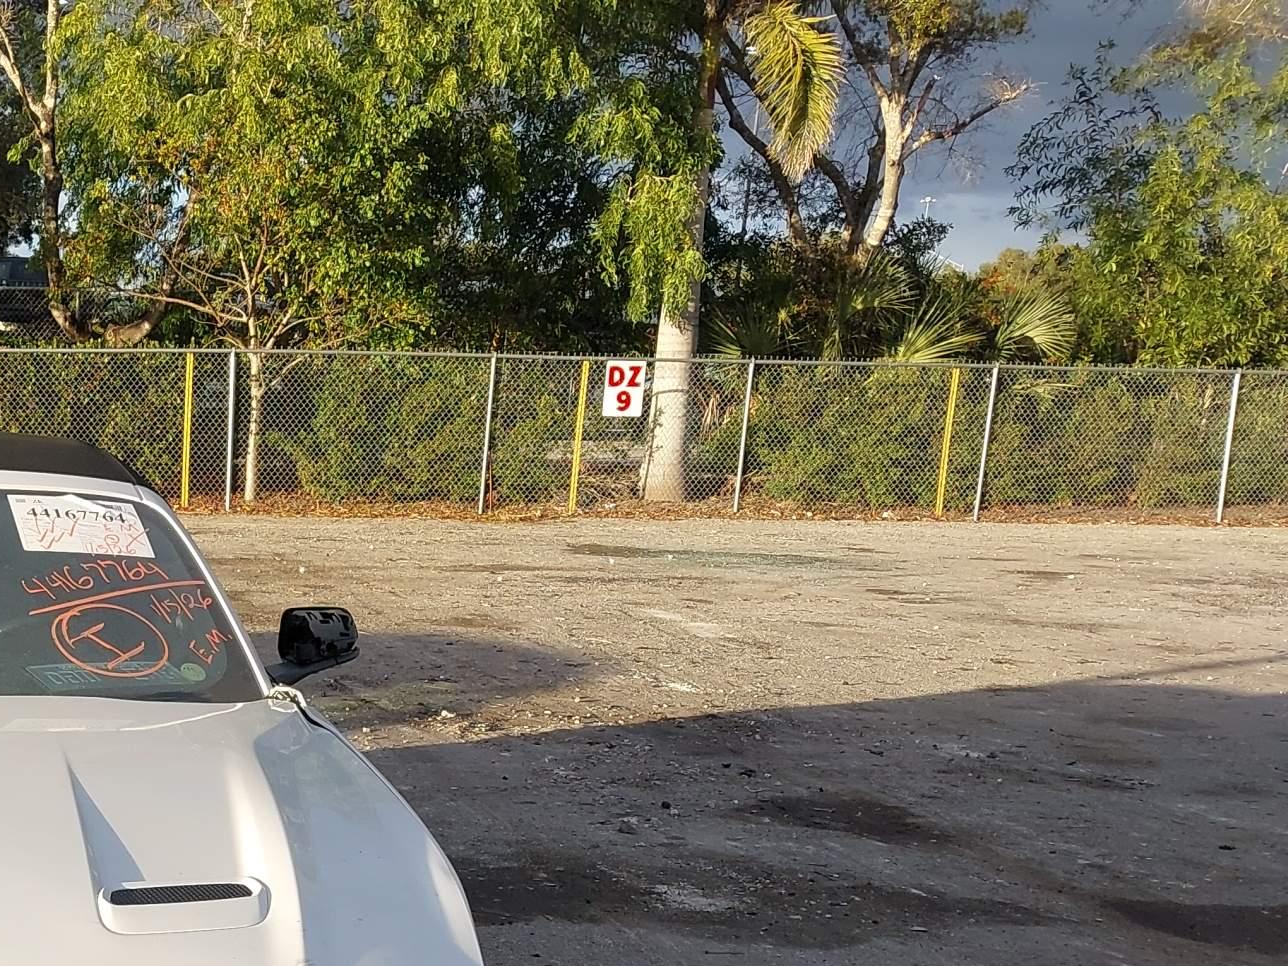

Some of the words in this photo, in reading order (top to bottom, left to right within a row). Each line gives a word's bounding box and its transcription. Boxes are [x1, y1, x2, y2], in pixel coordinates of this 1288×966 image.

[608, 366, 643, 387] DZ
[615, 390, 632, 412] 9
[26, 507, 126, 524] 44167764
[21, 559, 169, 599] 44167764
[149, 588, 213, 624] 1/15/26
